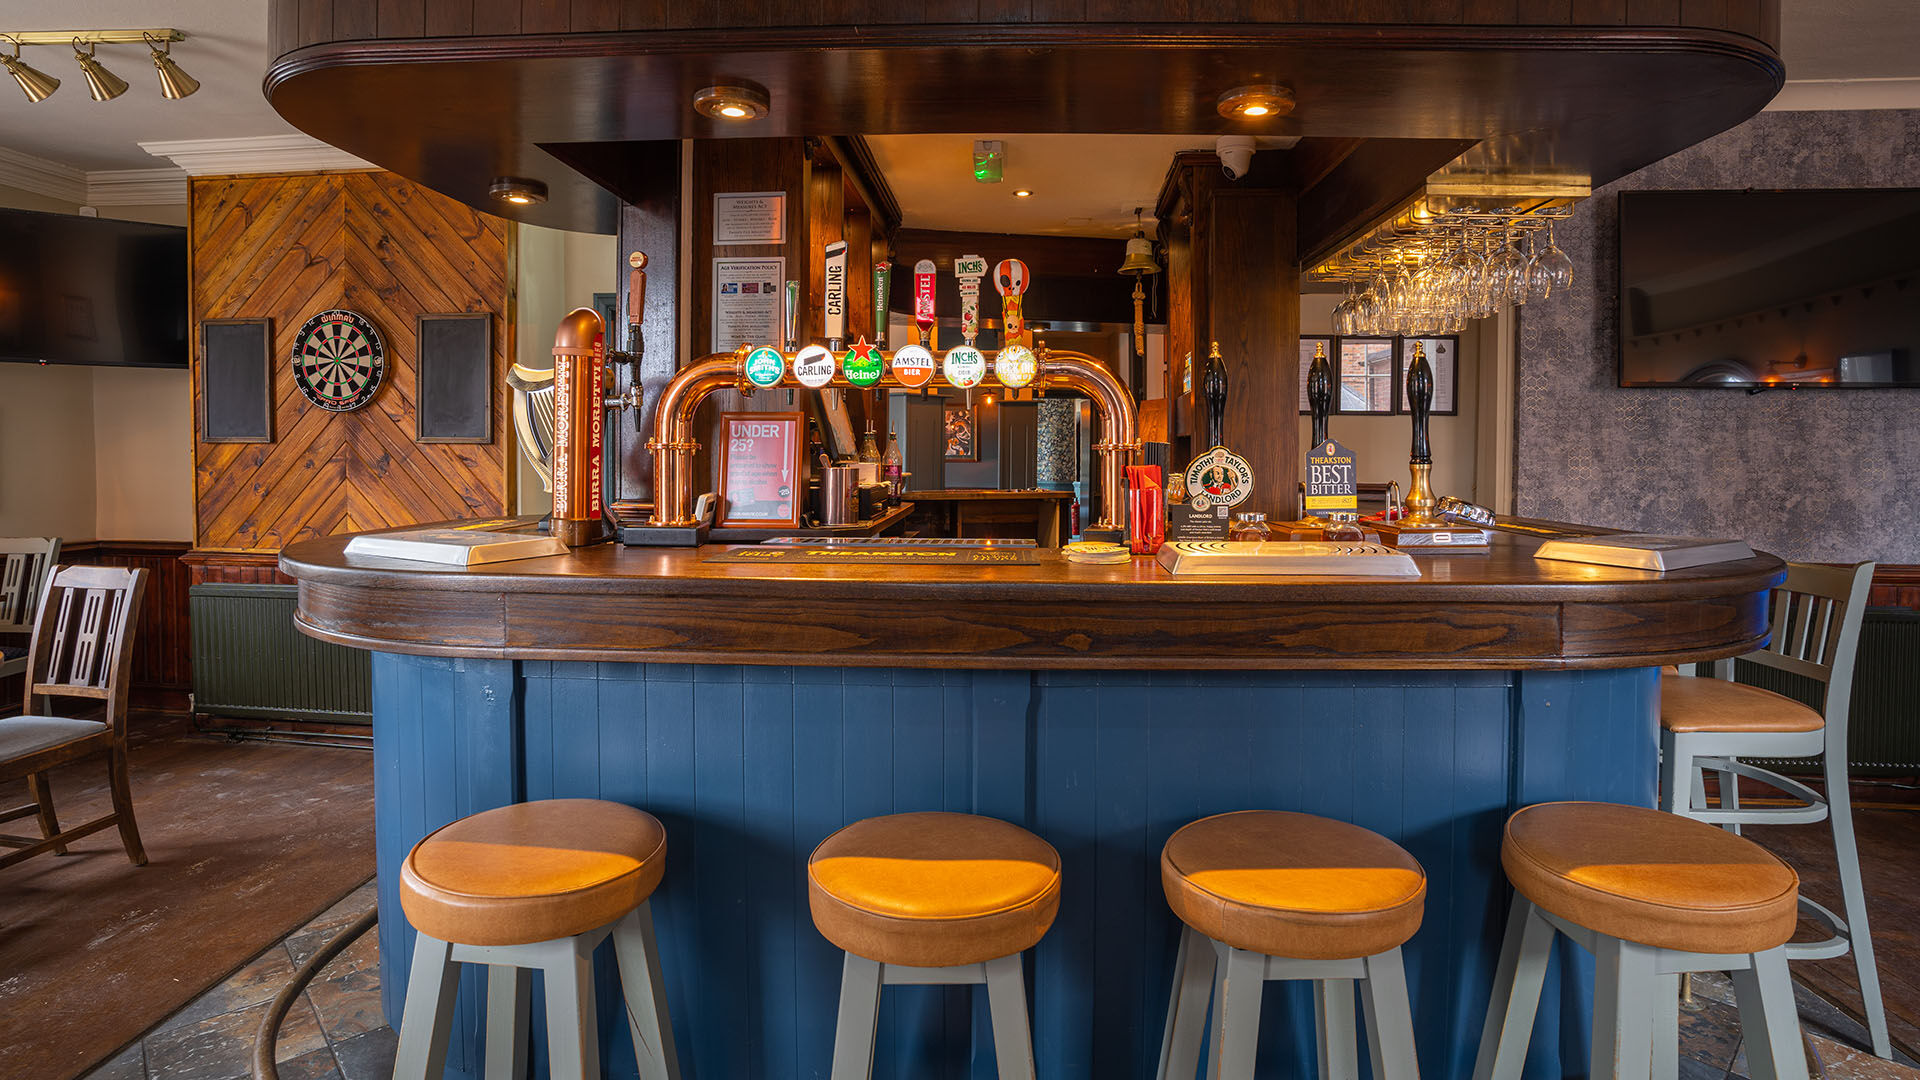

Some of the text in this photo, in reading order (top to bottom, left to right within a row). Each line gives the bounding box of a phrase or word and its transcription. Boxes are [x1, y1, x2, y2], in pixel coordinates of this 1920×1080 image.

[828, 266, 842, 315] CARLING
[920, 275, 930, 320] AMSTEL
[753, 358, 775, 366] JOHN
[895, 357, 931, 366] AMSTEL
[798, 365, 832, 376] CARLING
[592, 365, 602, 448] MORETTI
[731, 424, 780, 438] UNDER
[731, 439, 754, 452] 25?
[1190, 456, 1250, 484] TIMOTHY TAYLOR'S
[1311, 465, 1351, 484] BEST
[592, 454, 600, 512] BIRRA
[1311, 484, 1352, 495] BITTER
